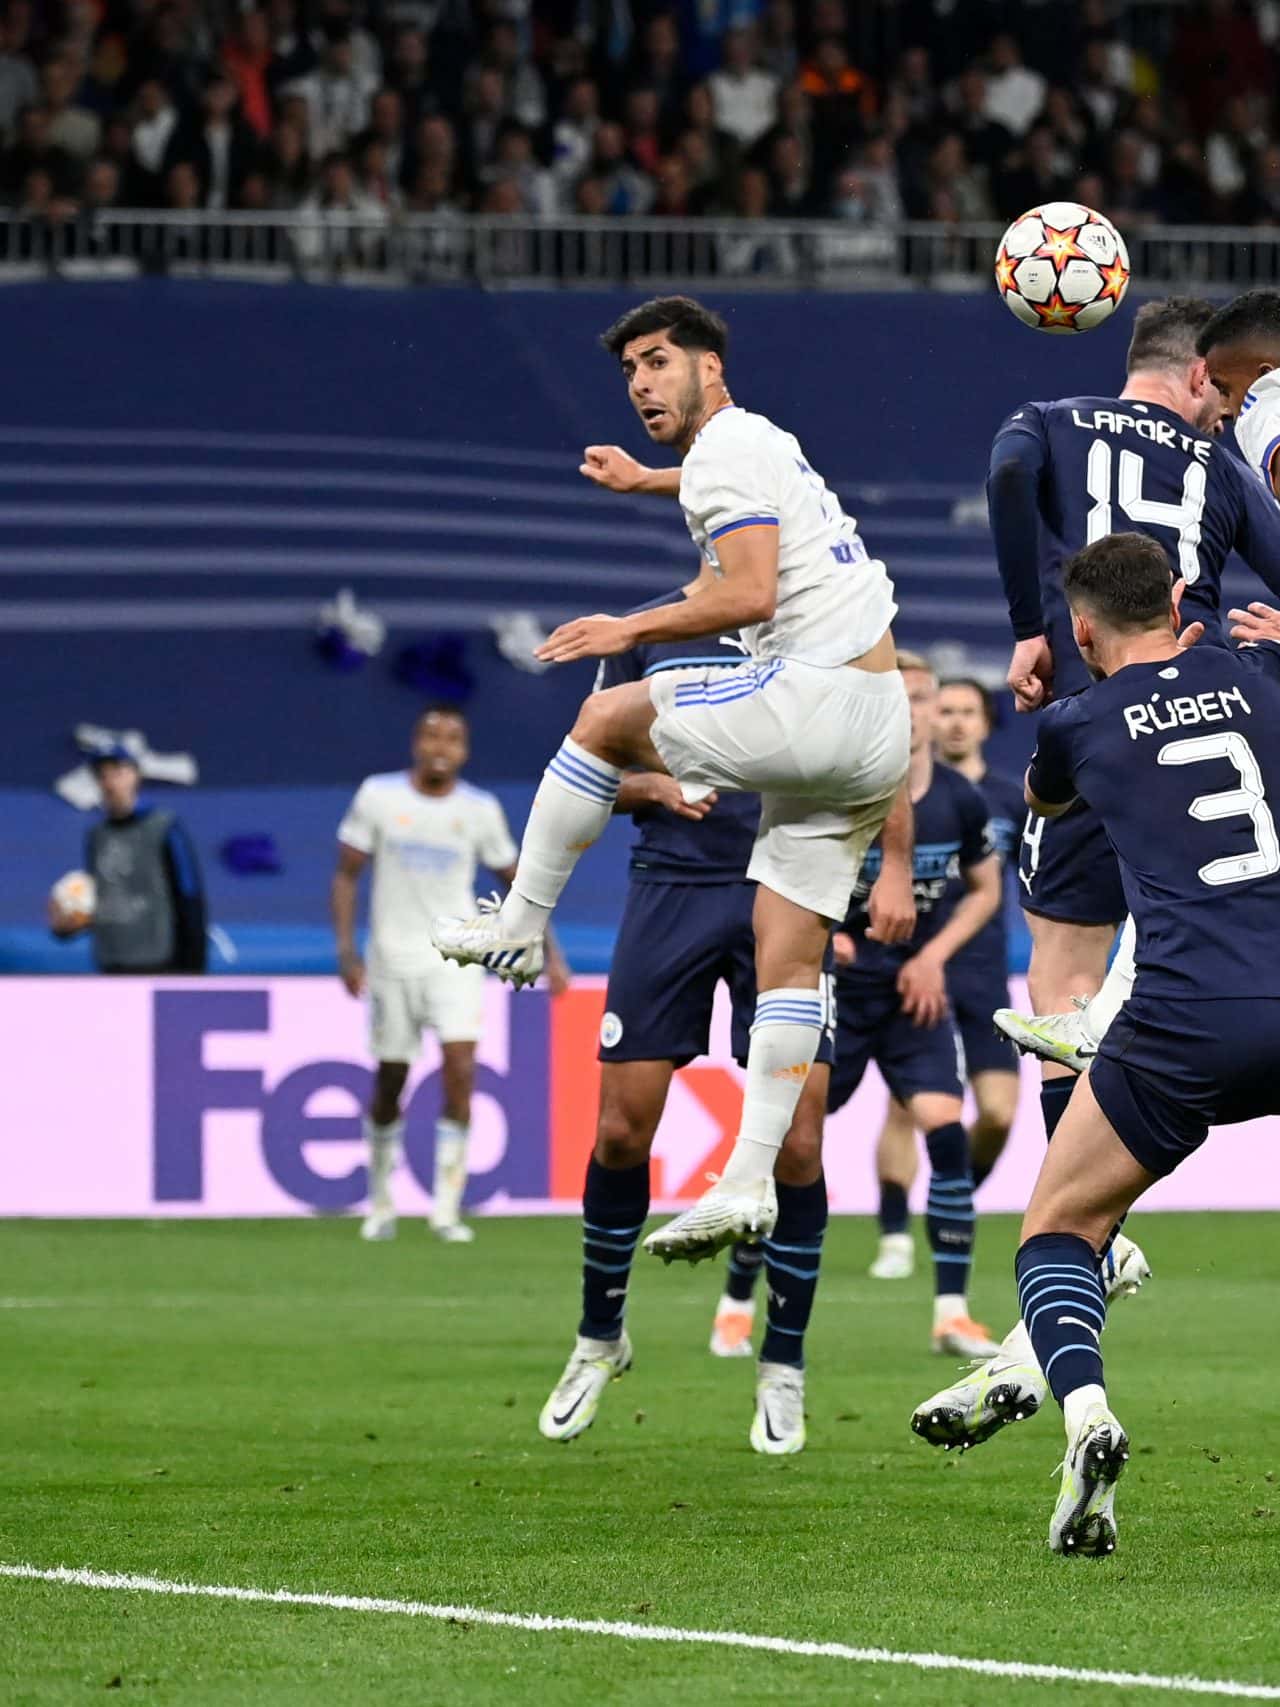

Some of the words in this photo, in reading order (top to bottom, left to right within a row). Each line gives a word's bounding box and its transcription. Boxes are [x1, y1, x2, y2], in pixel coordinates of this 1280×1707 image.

[1072, 409, 1213, 466] LAPORTE
[1087, 438, 1207, 586] 14
[1123, 686, 1252, 740] RÚBEN
